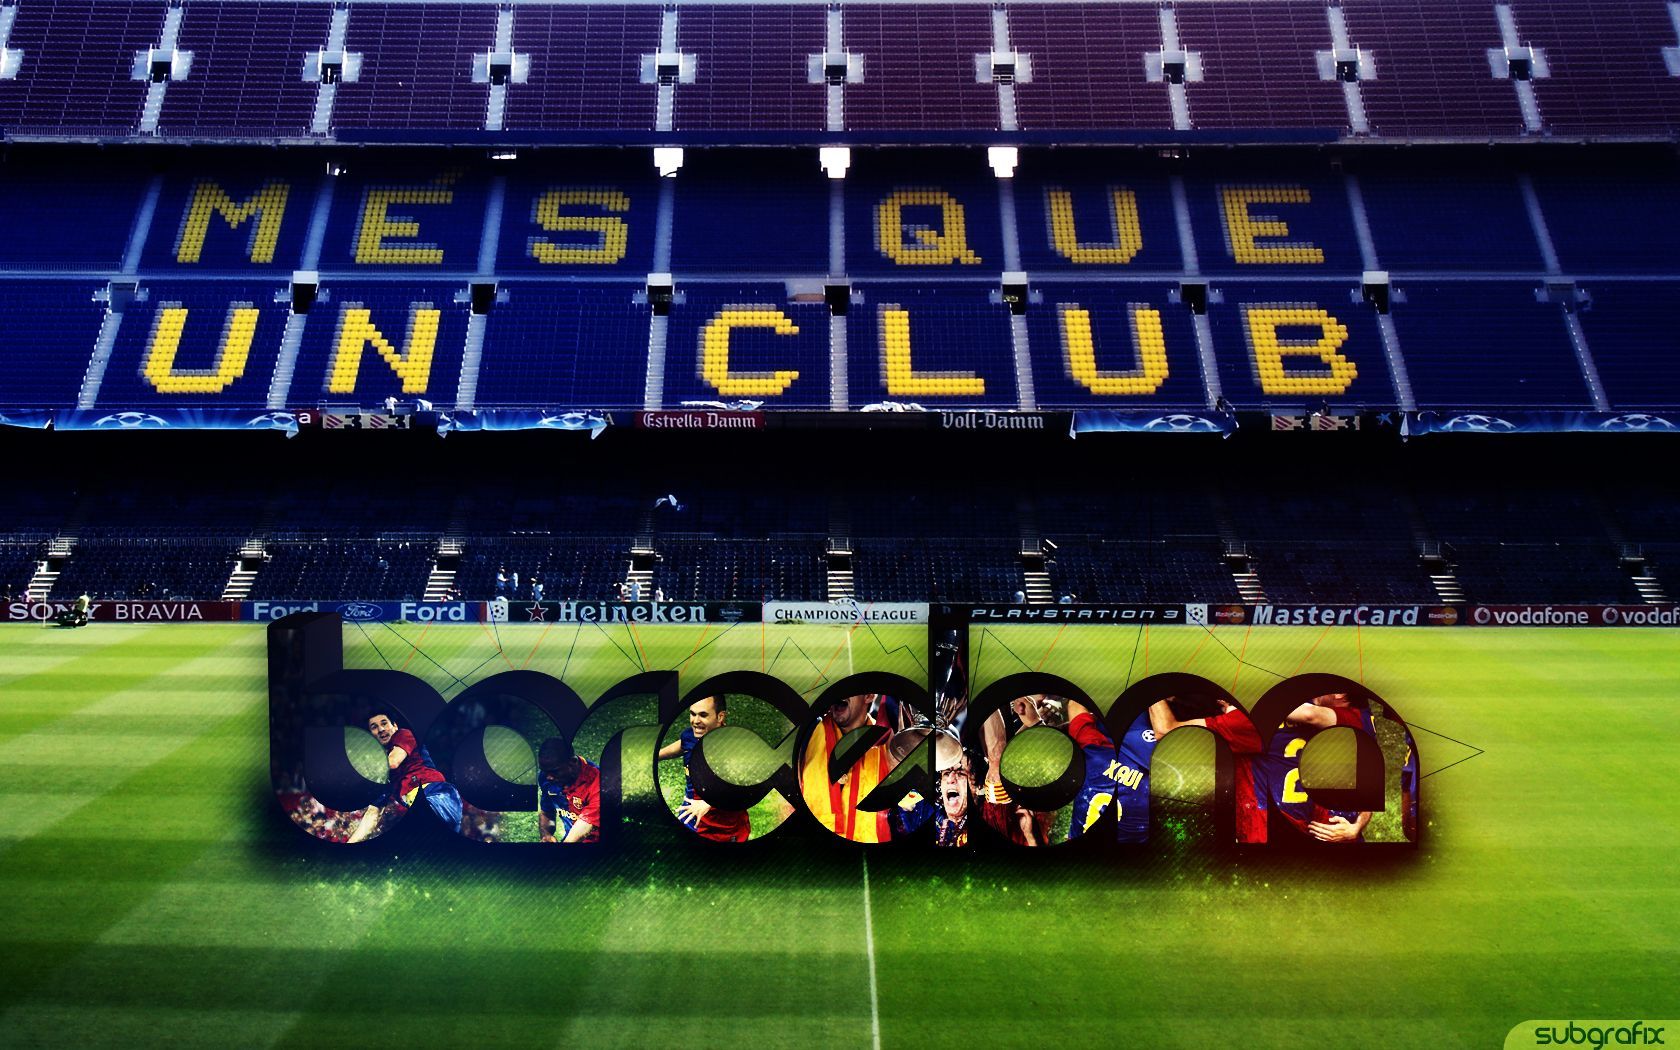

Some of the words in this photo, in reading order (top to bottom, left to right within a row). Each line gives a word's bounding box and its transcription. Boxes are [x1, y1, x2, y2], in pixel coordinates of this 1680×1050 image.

[873, 184, 1325, 265] QUE
[139, 301, 441, 393] UN
[696, 302, 1358, 396] CLUB
[643, 412, 702, 428] Estrella
[706, 412, 756, 428] Damm
[942, 411, 1044, 429] Voll-Damm
[115, 603, 203, 620] BRAVIA
[400, 602, 466, 621] Ford
[559, 601, 707, 622] Heineken
[774, 608, 858, 621] CHAMPIONS
[864, 608, 917, 620] LEAGUE
[971, 609, 1154, 619] PLAYSTATION
[1163, 609, 1179, 619] 3
[1252, 605, 1419, 625] MasterCard
[1493, 607, 1589, 625] vodafone
